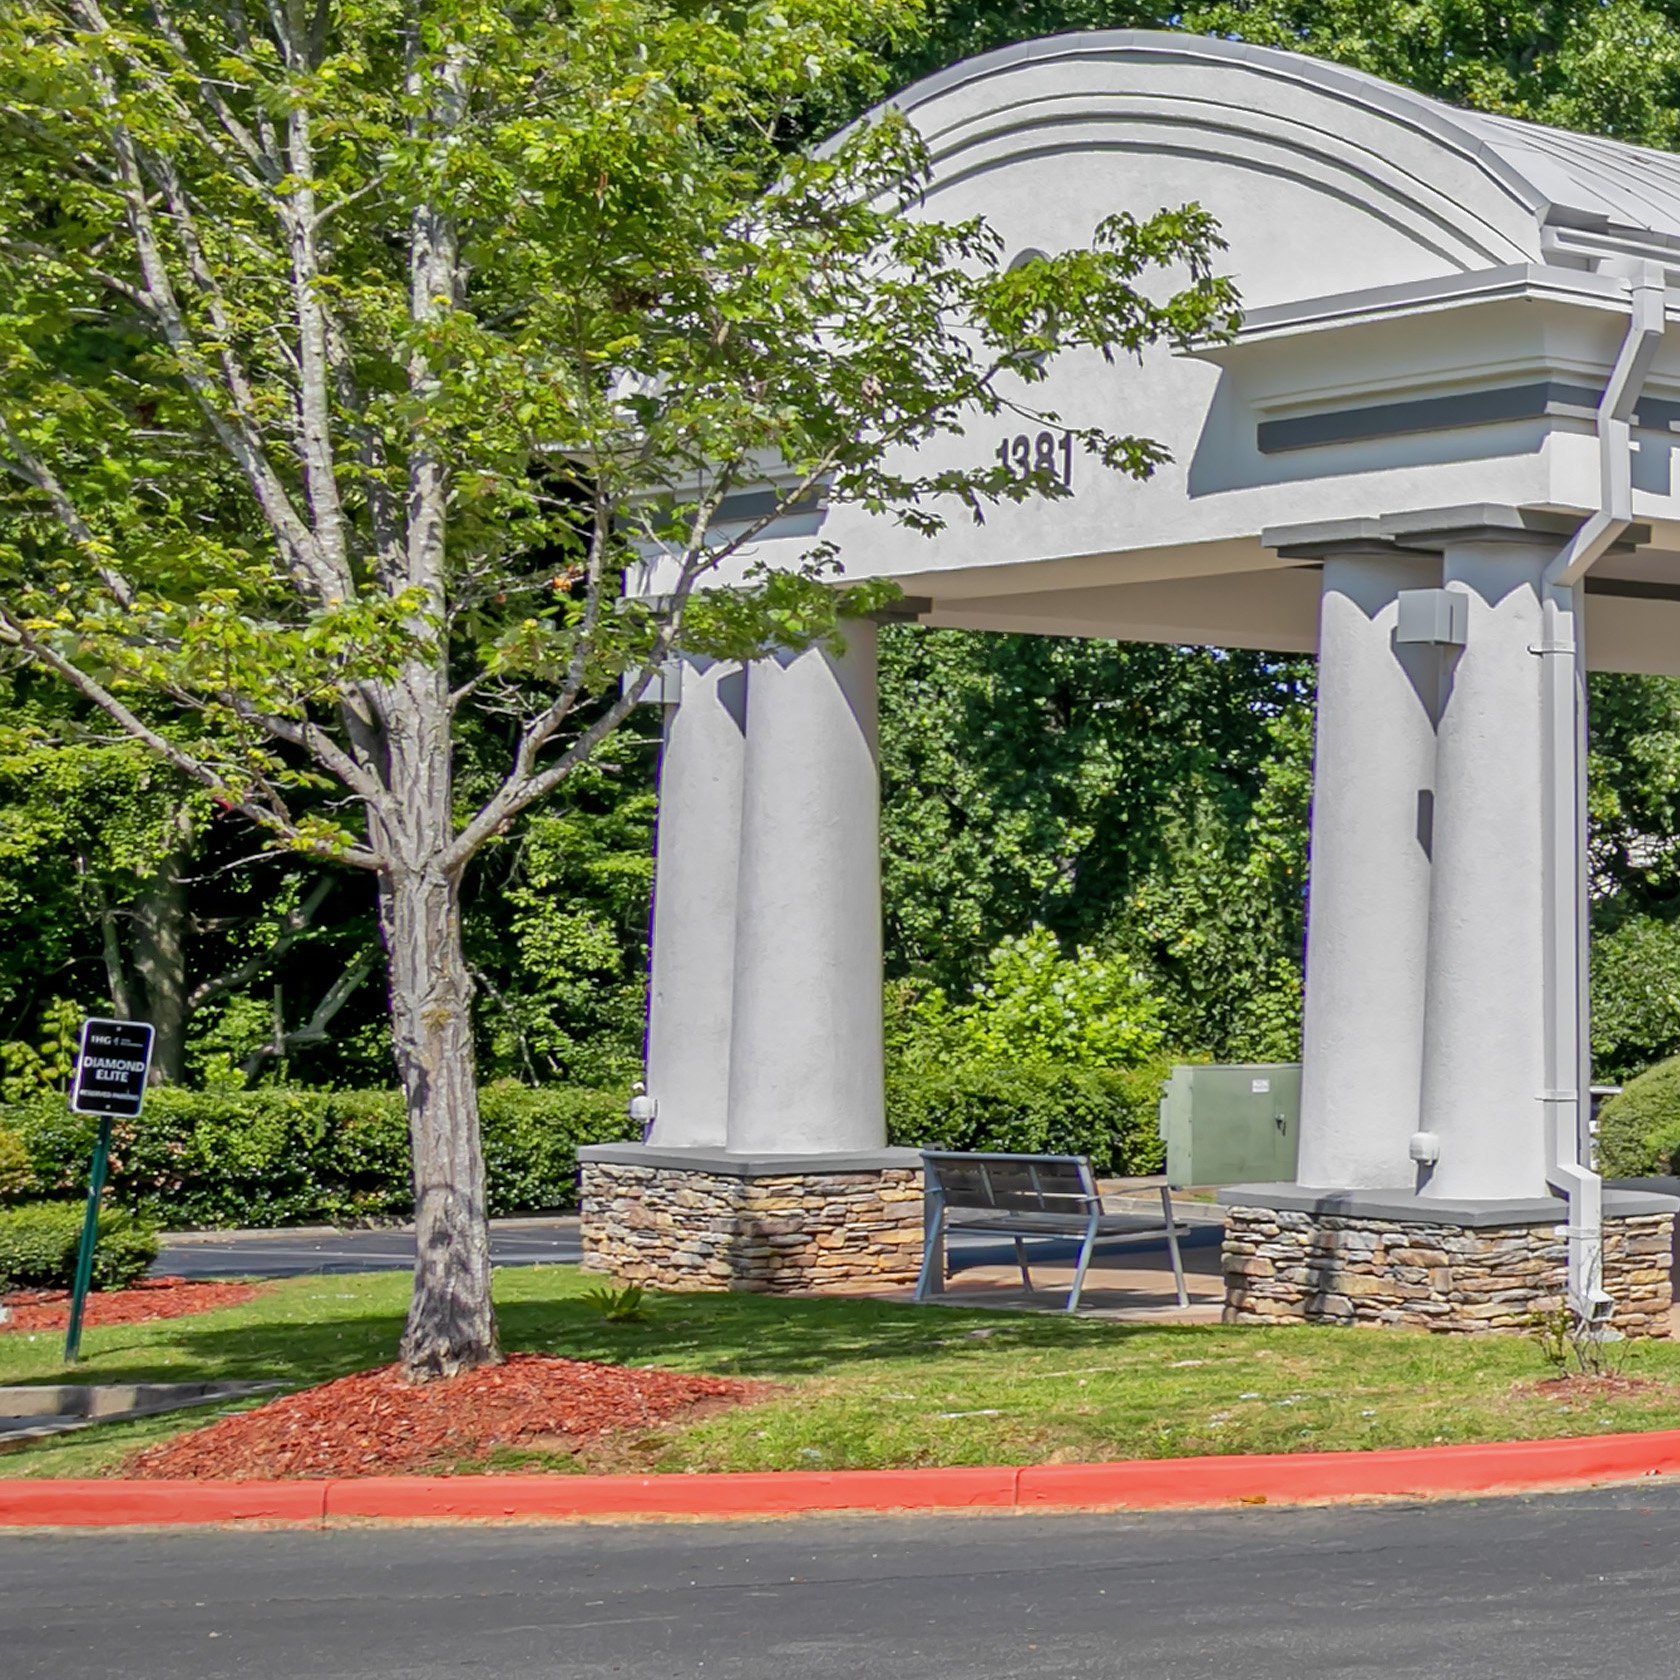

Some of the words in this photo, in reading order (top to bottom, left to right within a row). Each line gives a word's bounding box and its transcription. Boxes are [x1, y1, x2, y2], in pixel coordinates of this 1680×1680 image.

[996, 431, 1072, 487] 1381
[90, 1035, 112, 1045] IHG
[83, 1056, 145, 1072] DIAMOND
[95, 1069, 128, 1083] ELITE
